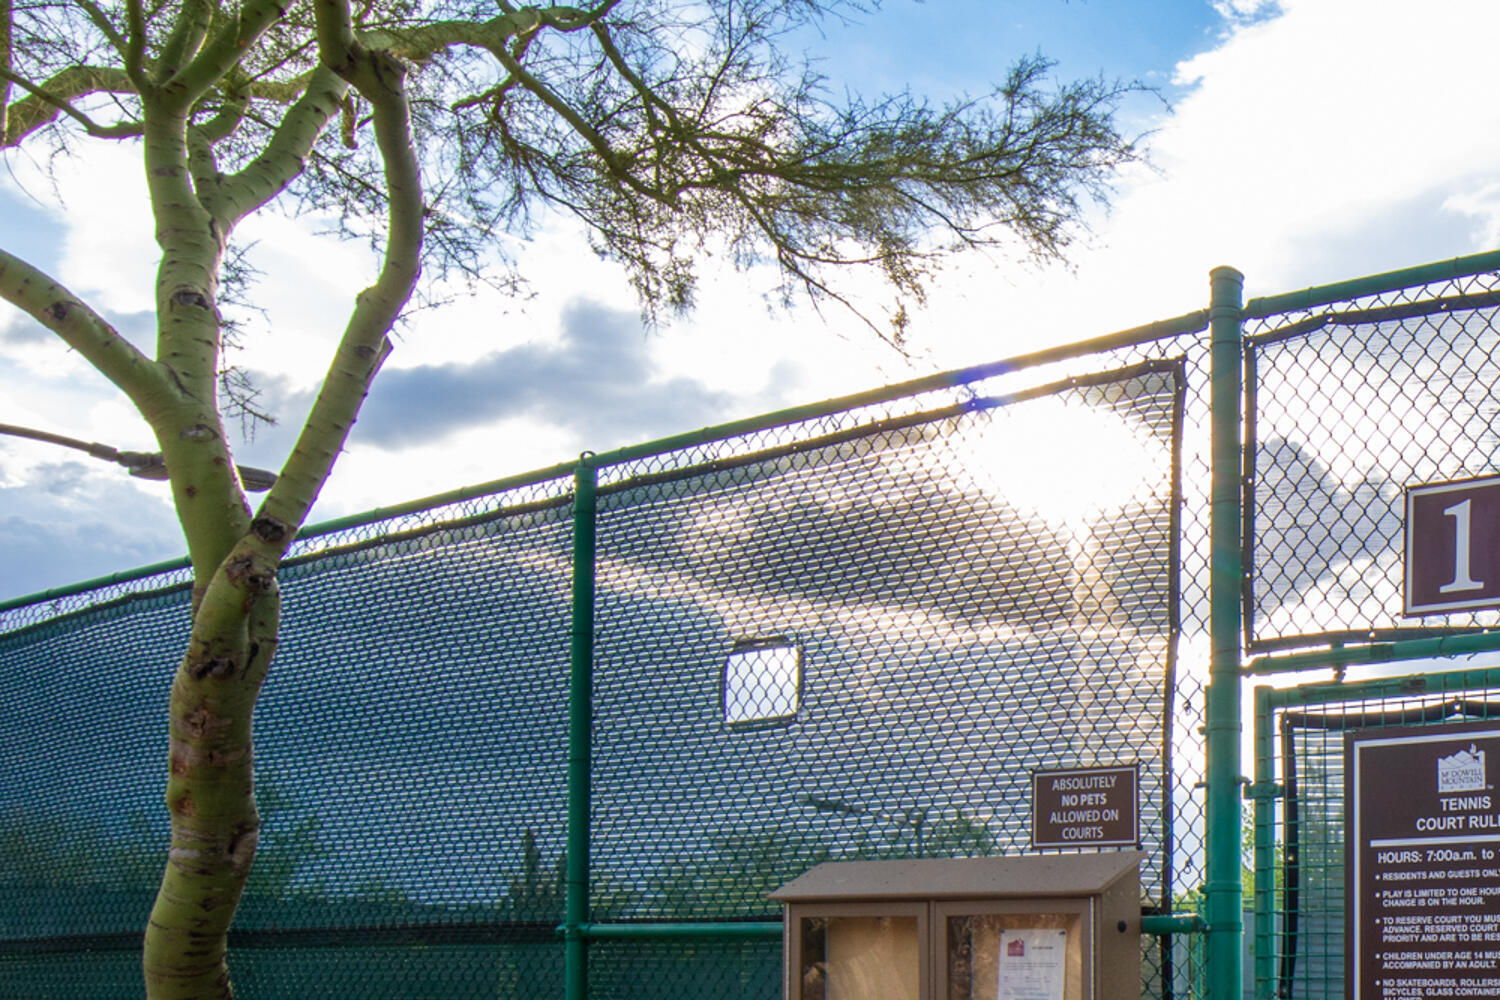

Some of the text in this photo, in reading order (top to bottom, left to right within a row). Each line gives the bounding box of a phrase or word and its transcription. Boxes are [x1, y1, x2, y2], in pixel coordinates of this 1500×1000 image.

[1440, 499, 1484, 593] 1
[1052, 776, 1117, 791] ABSOLUTELY
[1061, 793, 1107, 806] NO PETS
[1440, 796, 1491, 811] TENNIS
[1050, 809, 1118, 824] ALLOWED ON
[1416, 816, 1464, 831] COURT
[1062, 826, 1104, 839] COURTS
[1377, 851, 1422, 864] HOURS:
[1426, 849, 1476, 861] 7:00a.m.
[1482, 848, 1494, 860] to
[1383, 872, 1427, 880] RESIDENTS
[1428, 871, 1446, 879] AND
[1447, 870, 1480, 878] GUESTS
[1383, 890, 1402, 899] PLAY
[1414, 889, 1445, 897] LIMITED
[1460, 888, 1477, 896] ONE
[1383, 899, 1416, 907] CHANGE
[1459, 897, 1485, 905] HOUR.
[1383, 917, 1394, 925] TO
[1395, 916, 1432, 924] RESERVE
[1434, 916, 1462, 924] COURT
[1464, 915, 1481, 923] YOU
[1383, 925, 1422, 934] ADVANCE.
[1424, 925, 1468, 933] RESERVED
[1470, 924, 1498, 932] COURT
[1383, 934, 1419, 943] PRIORITY
[1421, 934, 1437, 942] AND
[1383, 952, 1423, 960] CHILDREN
[1425, 952, 1452, 960] UNDER
[1383, 961, 1497, 969] ACCOMPANIED BY AN ADULT.
[1397, 979, 1458, 988] SKATEBOARDS,
[1383, 988, 1424, 997] BICYCLES,
[1426, 988, 1453, 996] GLASS
